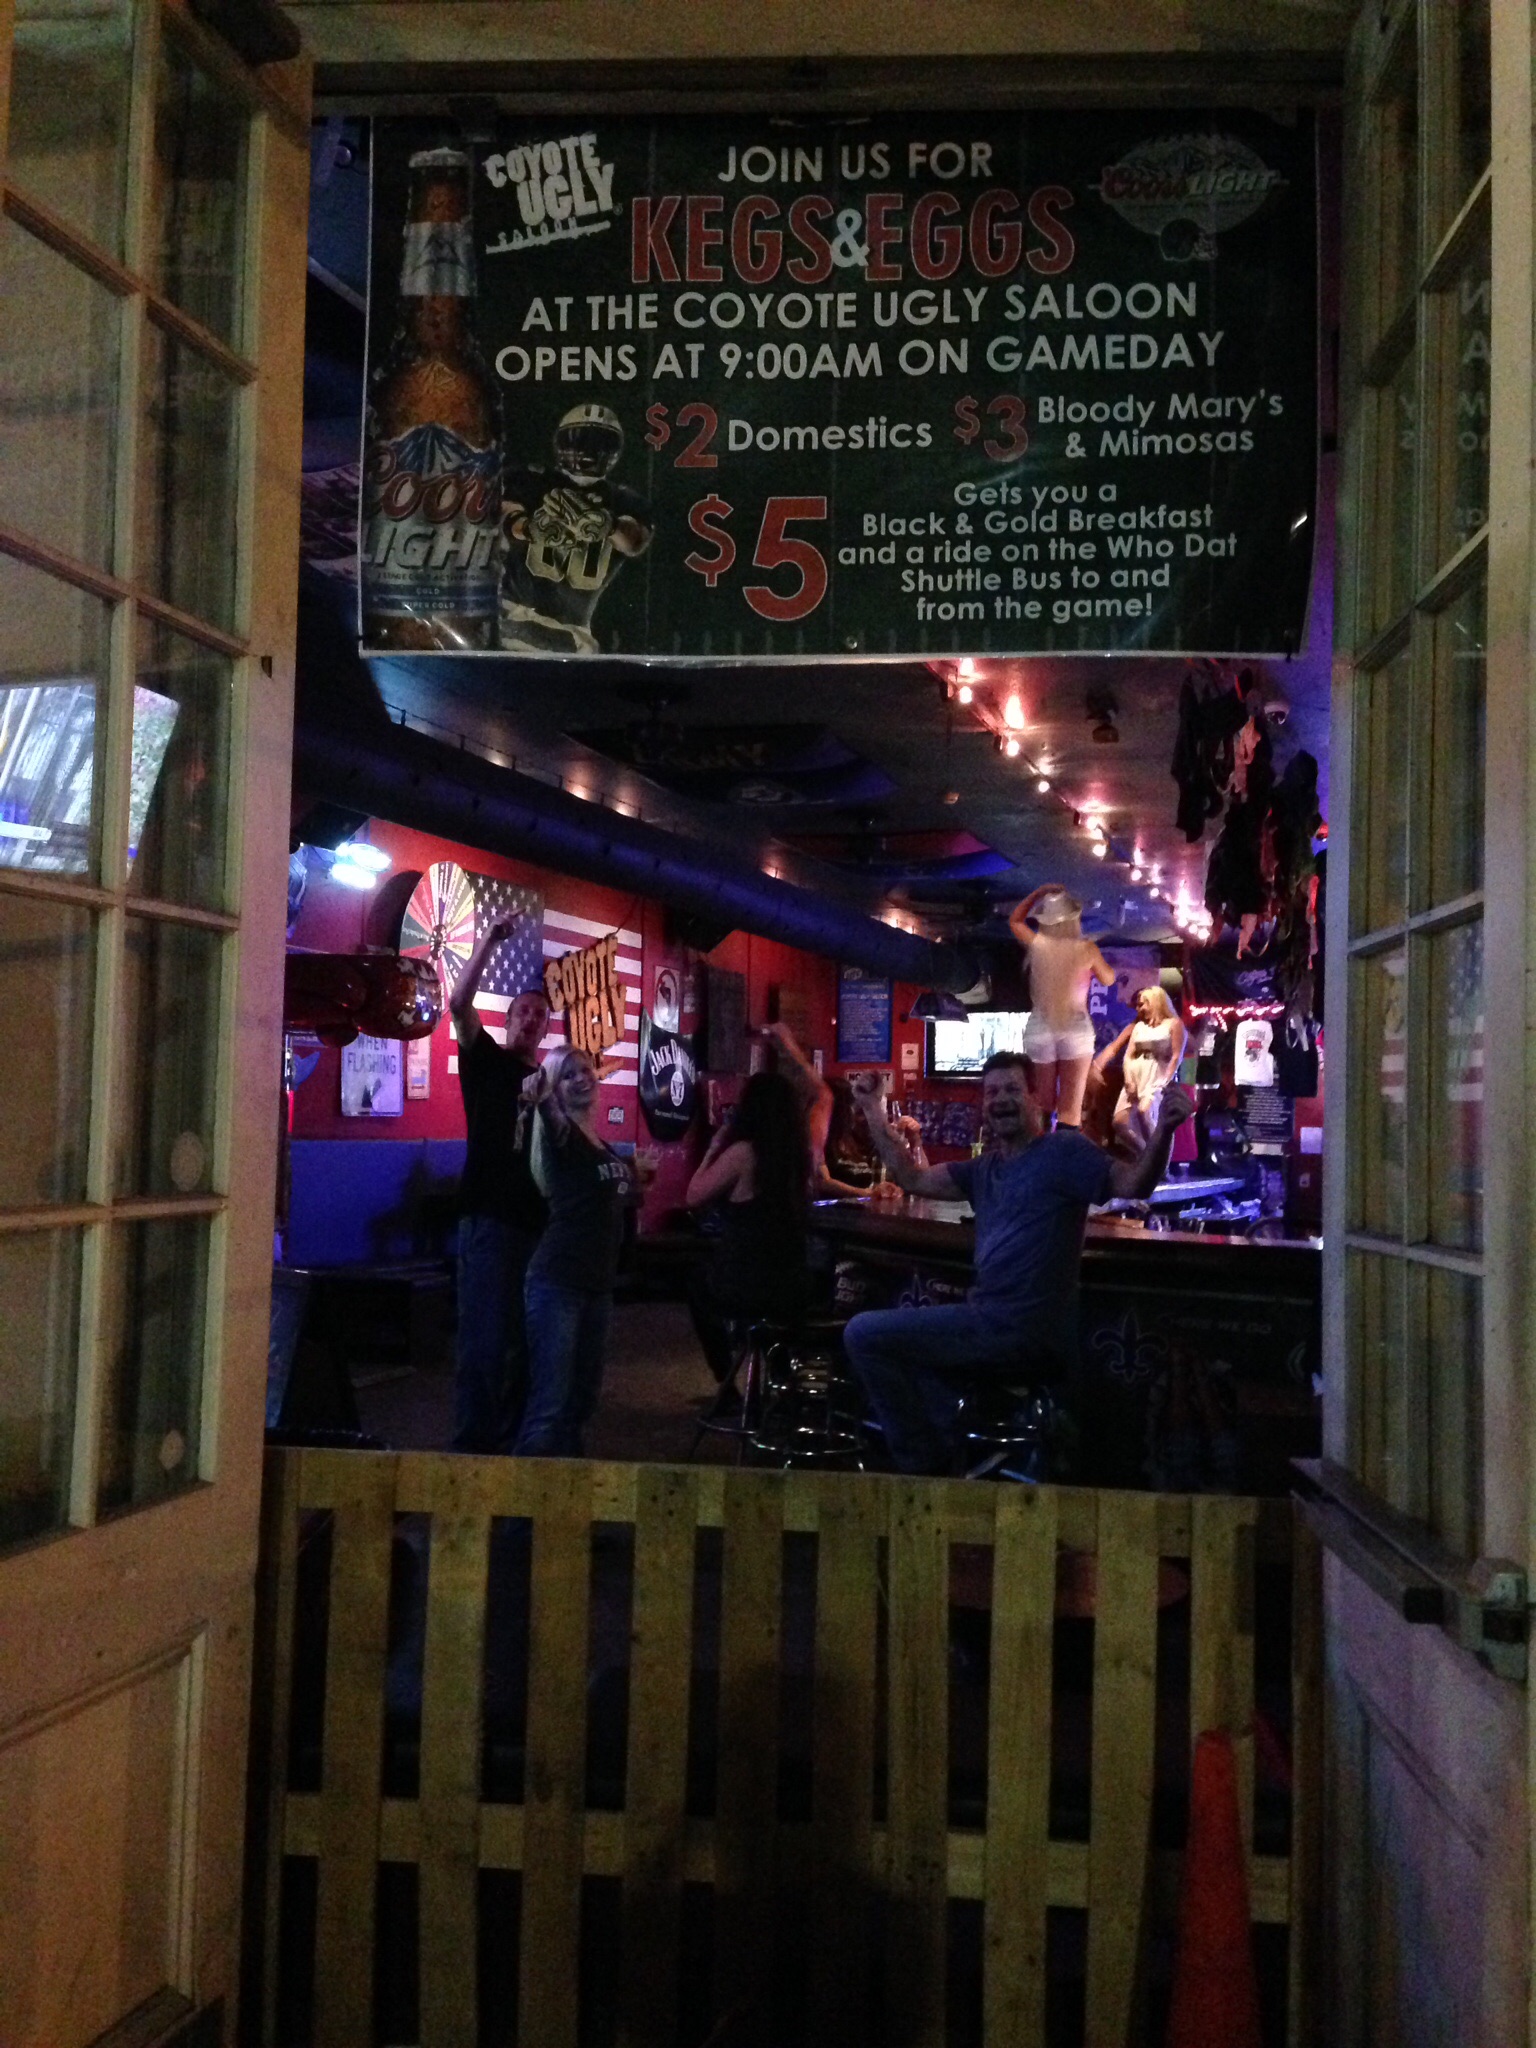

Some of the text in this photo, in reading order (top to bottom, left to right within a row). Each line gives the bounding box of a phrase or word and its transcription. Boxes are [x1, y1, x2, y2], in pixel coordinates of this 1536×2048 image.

[483, 131, 600, 189] COYOTE
[719, 142, 993, 183] JOIN US FOR
[516, 163, 615, 226] UGLY
[522, 282, 1197, 332] AT THE COYOTE UGLY SALOON
[495, 331, 1225, 382] OPENS AT 9:00AM ON GAMEDAY
[644, 402, 933, 468] $2 Domestics
[953, 389, 1284, 463] $3 Bloody Mary's
[1064, 428, 1255, 458] & Mimosas
[954, 481, 1118, 510] Gets you a
[863, 504, 1213, 537] Black & Gold Breakfast
[362, 525, 499, 569] LIGHT
[684, 494, 829, 622] $5
[838, 532, 1237, 565] and a ride on the Who Dat
[901, 563, 1170, 594] Shuttle Bus to and
[432, 601, 456, 609] COLD
[916, 593, 1153, 624] from the game!
[543, 935, 620, 1012] COYOTE
[568, 982, 628, 1053] UGLY
[347, 1052, 397, 1075] FLASHING
[650, 1044, 672, 1077] JACK
